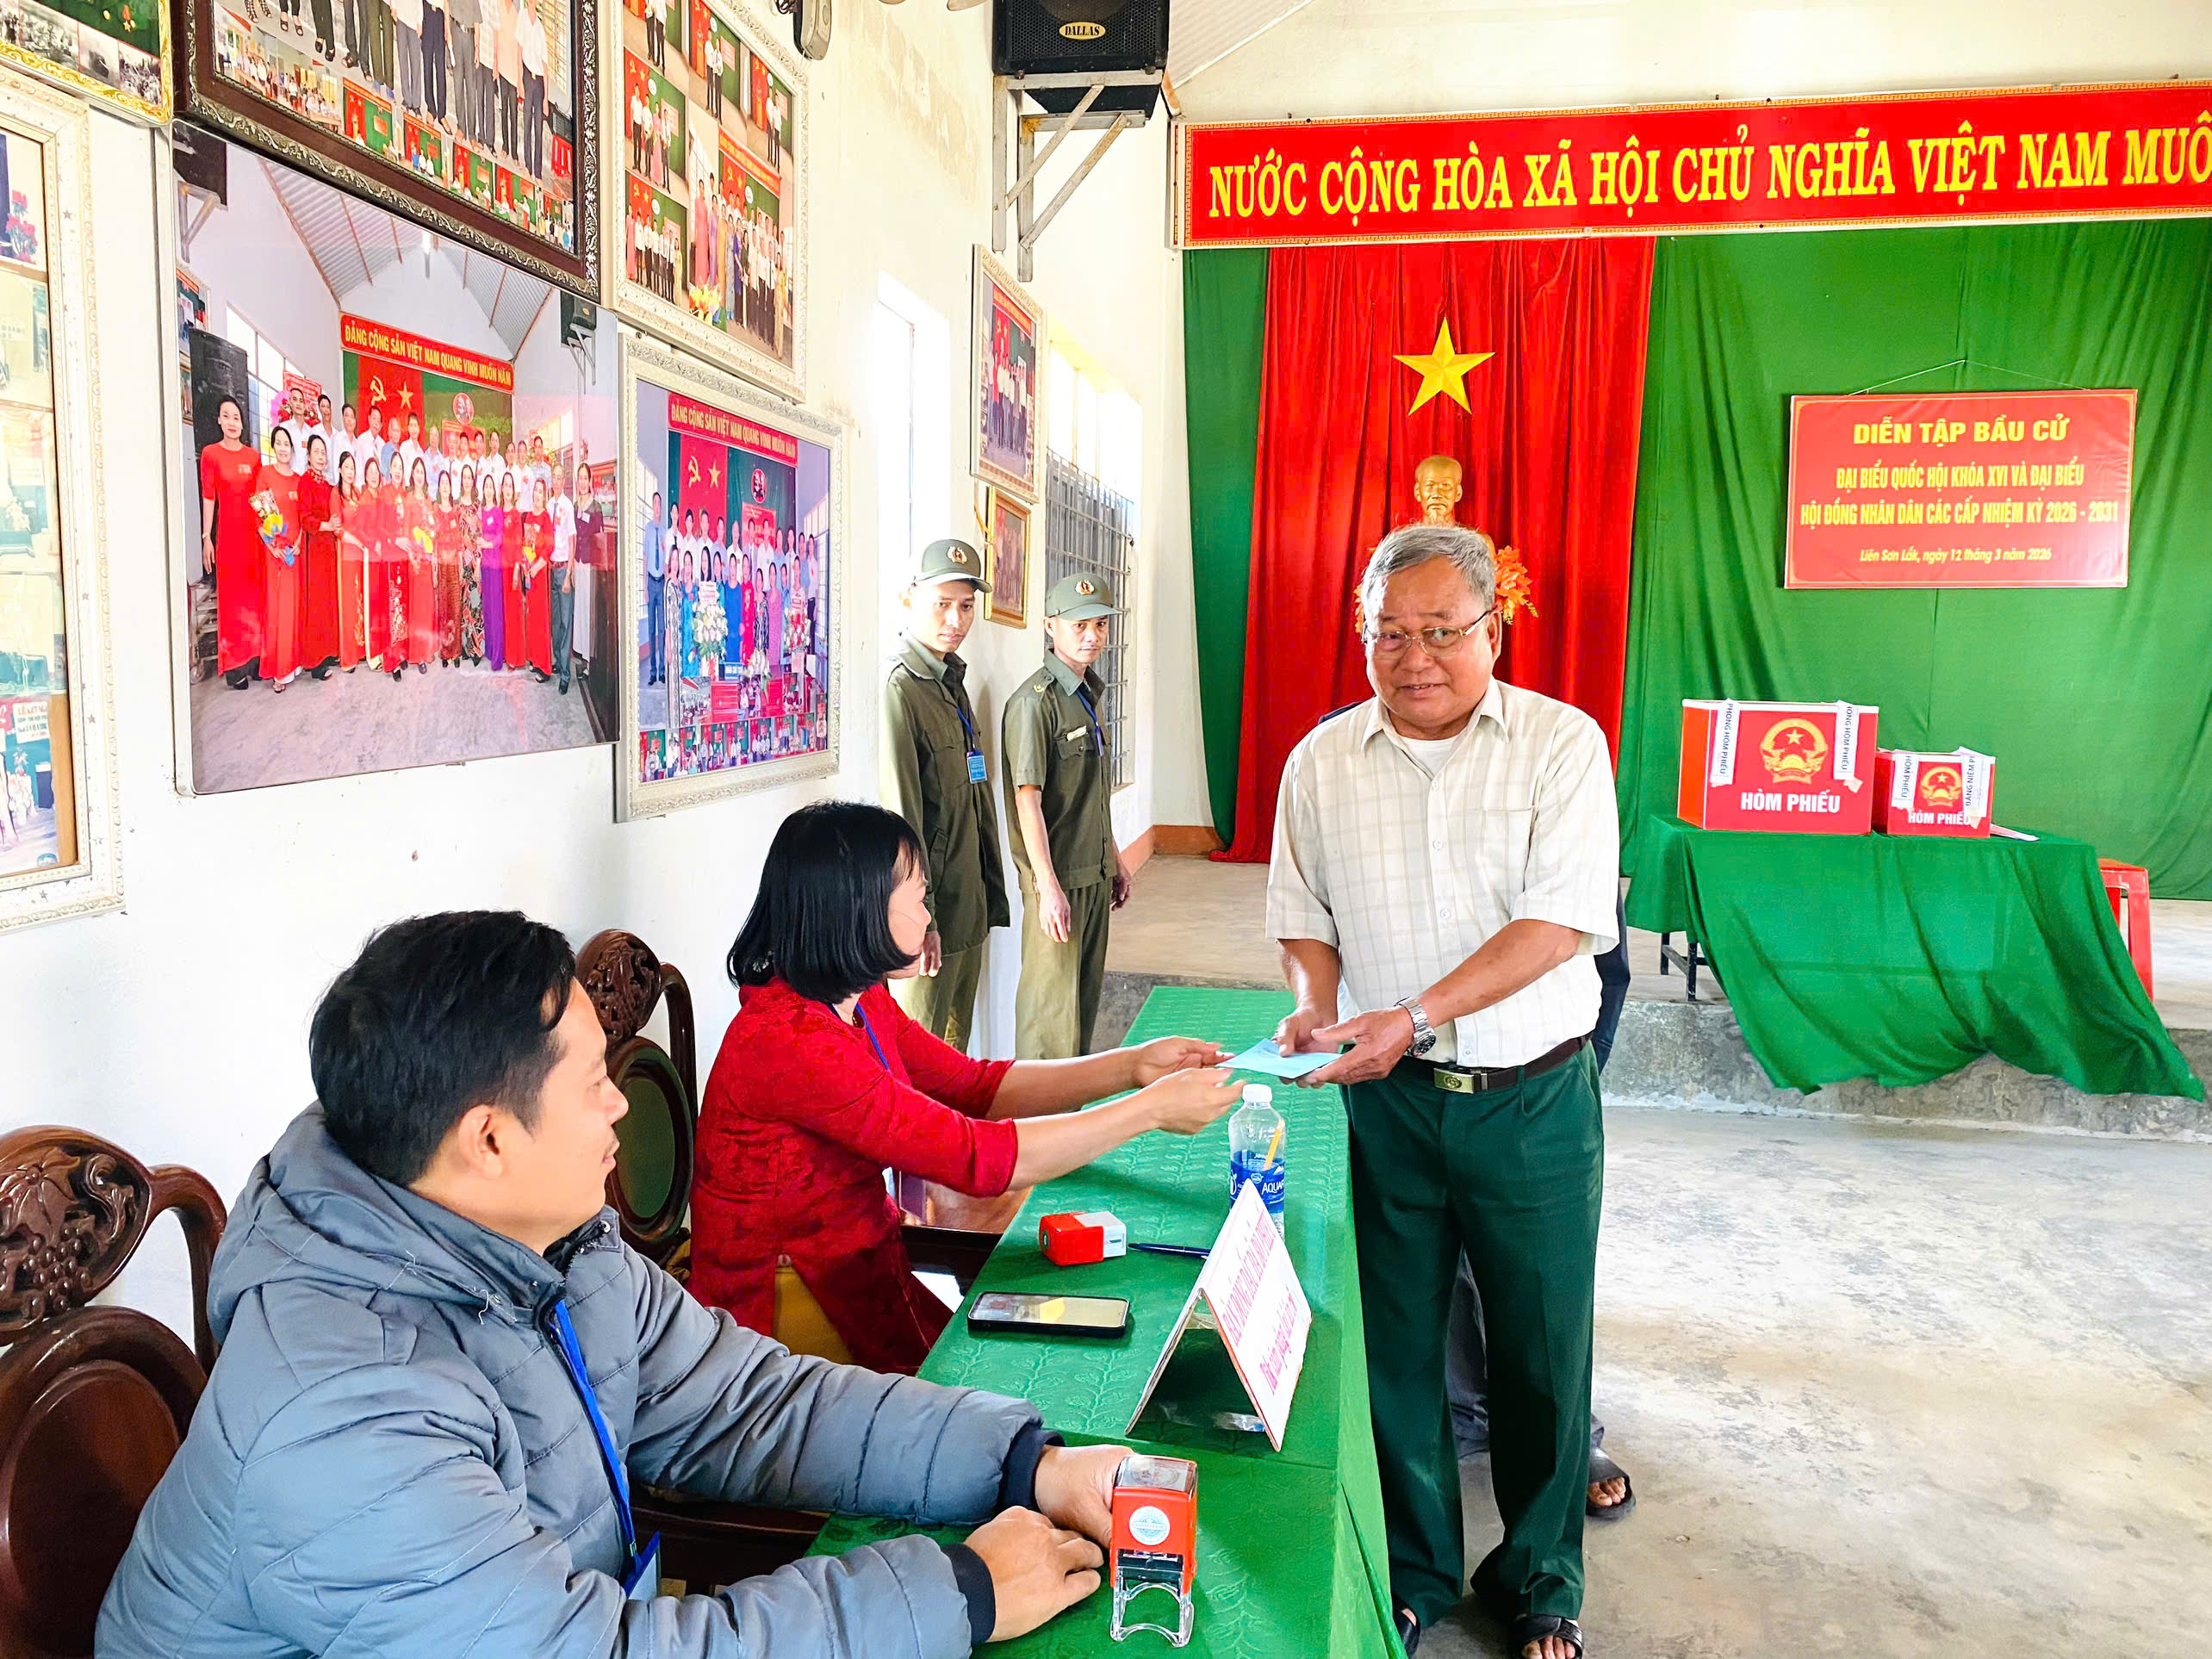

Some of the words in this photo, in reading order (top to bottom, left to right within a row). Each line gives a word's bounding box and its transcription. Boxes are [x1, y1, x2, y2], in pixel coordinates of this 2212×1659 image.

[1065, 26, 1100, 35] DALLAS
[1209, 147, 1306, 217] NƯỚC
[1320, 146, 1420, 227] CỘNG
[1432, 140, 1513, 211] HÒA
[1523, 139, 1576, 207] XÃ
[1590, 134, 1660, 218] HỘI
[1673, 124, 1755, 203] CHỦ
[1767, 127, 1895, 199] NGHĨA
[1908, 120, 2004, 206] VIỆT
[2016, 131, 2110, 189] NAM
[345, 320, 367, 346] ĐẢNG
[369, 329, 389, 351] CỘNG
[391, 333, 406, 357] SẢN
[407, 340, 422, 363] VIỆT
[425, 347, 439, 365] NAM
[441, 352, 463, 372] QUANG
[1854, 416, 1911, 444] DIỄN
[1919, 418, 1966, 447] TẬP
[1974, 414, 2025, 442] BẦU
[2033, 413, 2070, 441] CỬ
[1836, 468, 1858, 494] ĐẠI
[1860, 459, 1888, 488] BIỂU
[1892, 459, 1924, 490] QUỐC
[1927, 462, 1948, 492] HỘI
[1951, 462, 1985, 488] KHÓA
[1987, 465, 2008, 487] XVI
[2011, 460, 2027, 487] VÀ
[2030, 464, 2053, 491] ĐẠI
[2055, 456, 2085, 486] BIỂU
[1801, 500, 1821, 530] HỘI
[1861, 499, 1895, 525] NHÂN
[1898, 499, 1923, 525] DÂN
[1926, 499, 1951, 525] CÁC
[1954, 495, 1979, 524] CẤP
[1983, 497, 2023, 528] NHIỆM
[2026, 497, 2044, 524] KỲ
[2046, 501, 2077, 523] 2026
[2088, 500, 2118, 523] 2031
[1860, 549, 1880, 561] Liên
[1881, 549, 1899, 561] Sơn
[1923, 547, 1948, 564] ngày
[1951, 549, 1962, 561] 12
[1964, 547, 1992, 563] tháng
[1994, 548, 2002, 560] 3
[2003, 547, 2026, 560] năm
[2027, 548, 2052, 560] 2026
[1724, 703, 1734, 730] PHONG
[1842, 728, 1851, 745] HÒM
[1841, 747, 1850, 770] PHIẾU
[1904, 755, 1912, 774] HÒM
[1901, 774, 1911, 798] PHIẾU
[1966, 765, 1974, 784] NIÊM
[1741, 788, 1782, 811] HÒM
[1786, 789, 1840, 813] PHIẾU
[1909, 810, 1935, 823] HÒM
